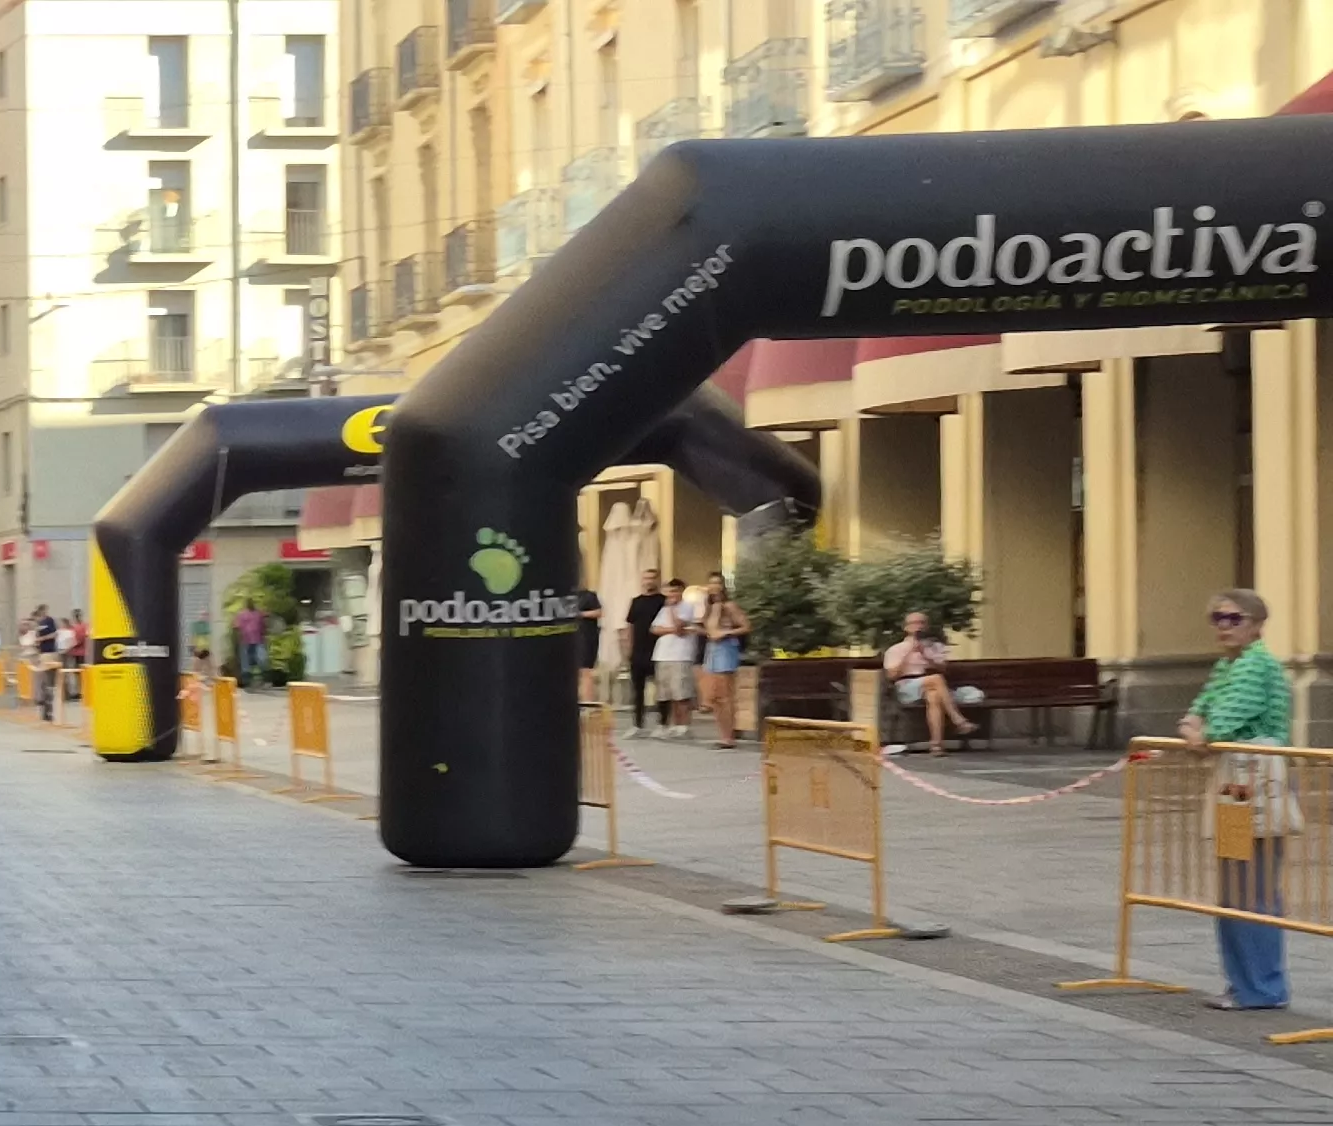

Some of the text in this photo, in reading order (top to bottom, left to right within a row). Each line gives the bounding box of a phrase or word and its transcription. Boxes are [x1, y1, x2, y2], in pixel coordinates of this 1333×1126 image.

[820, 205, 1319, 317] podoactiva
[891, 282, 1309, 315] PODOLOGÍA Y BIOMECÁNICA
[497, 244, 733, 459] Pisa bien, vive mejor
[398, 588, 579, 636] podoactiva
